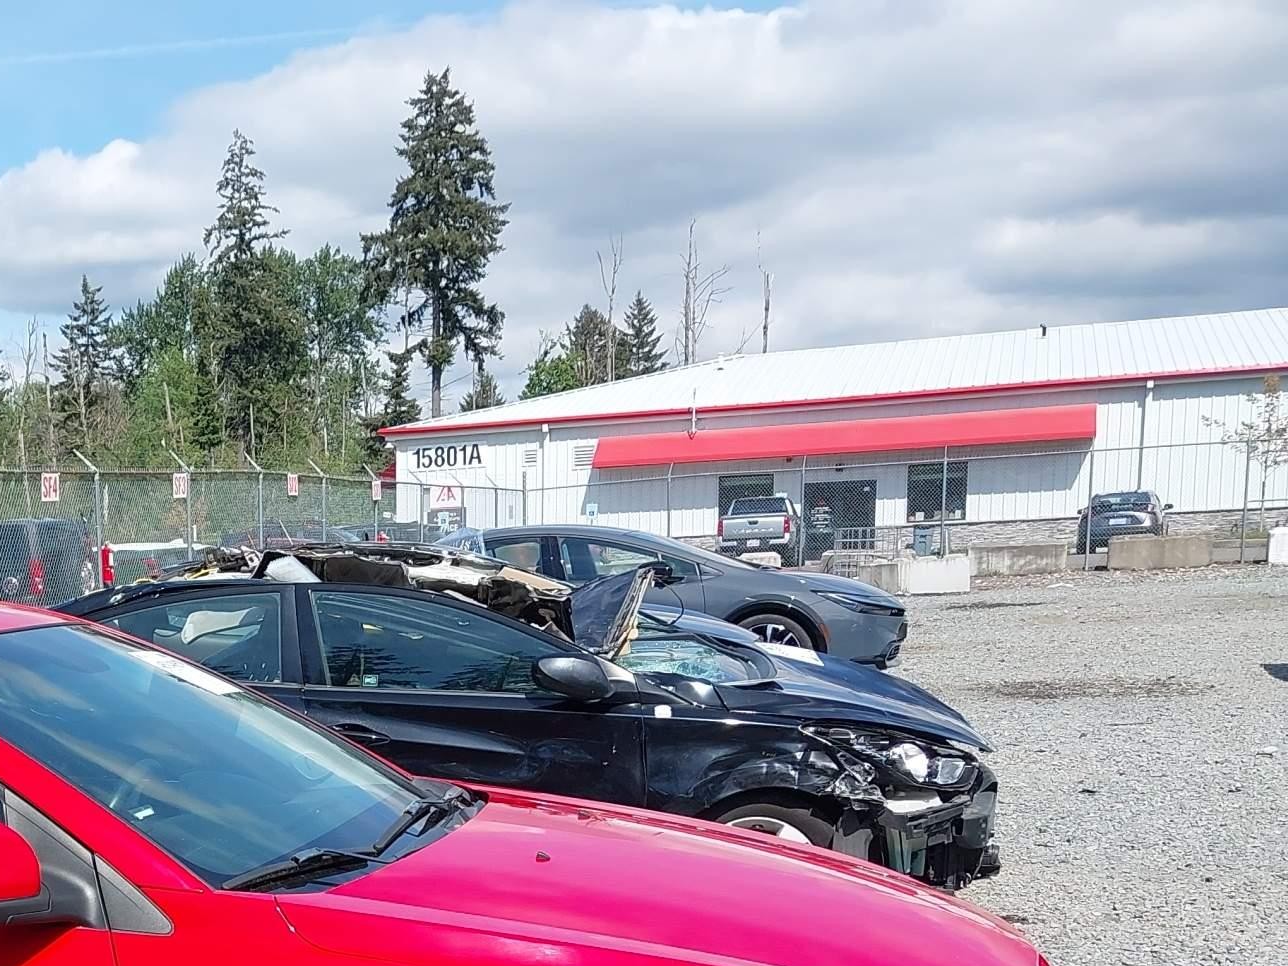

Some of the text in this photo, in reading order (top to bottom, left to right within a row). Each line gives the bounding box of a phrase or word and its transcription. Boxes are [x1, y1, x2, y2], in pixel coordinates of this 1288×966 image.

[413, 443, 482, 469] 15801A
[43, 476, 57, 499] SF4
[174, 476, 186, 495] SF3
